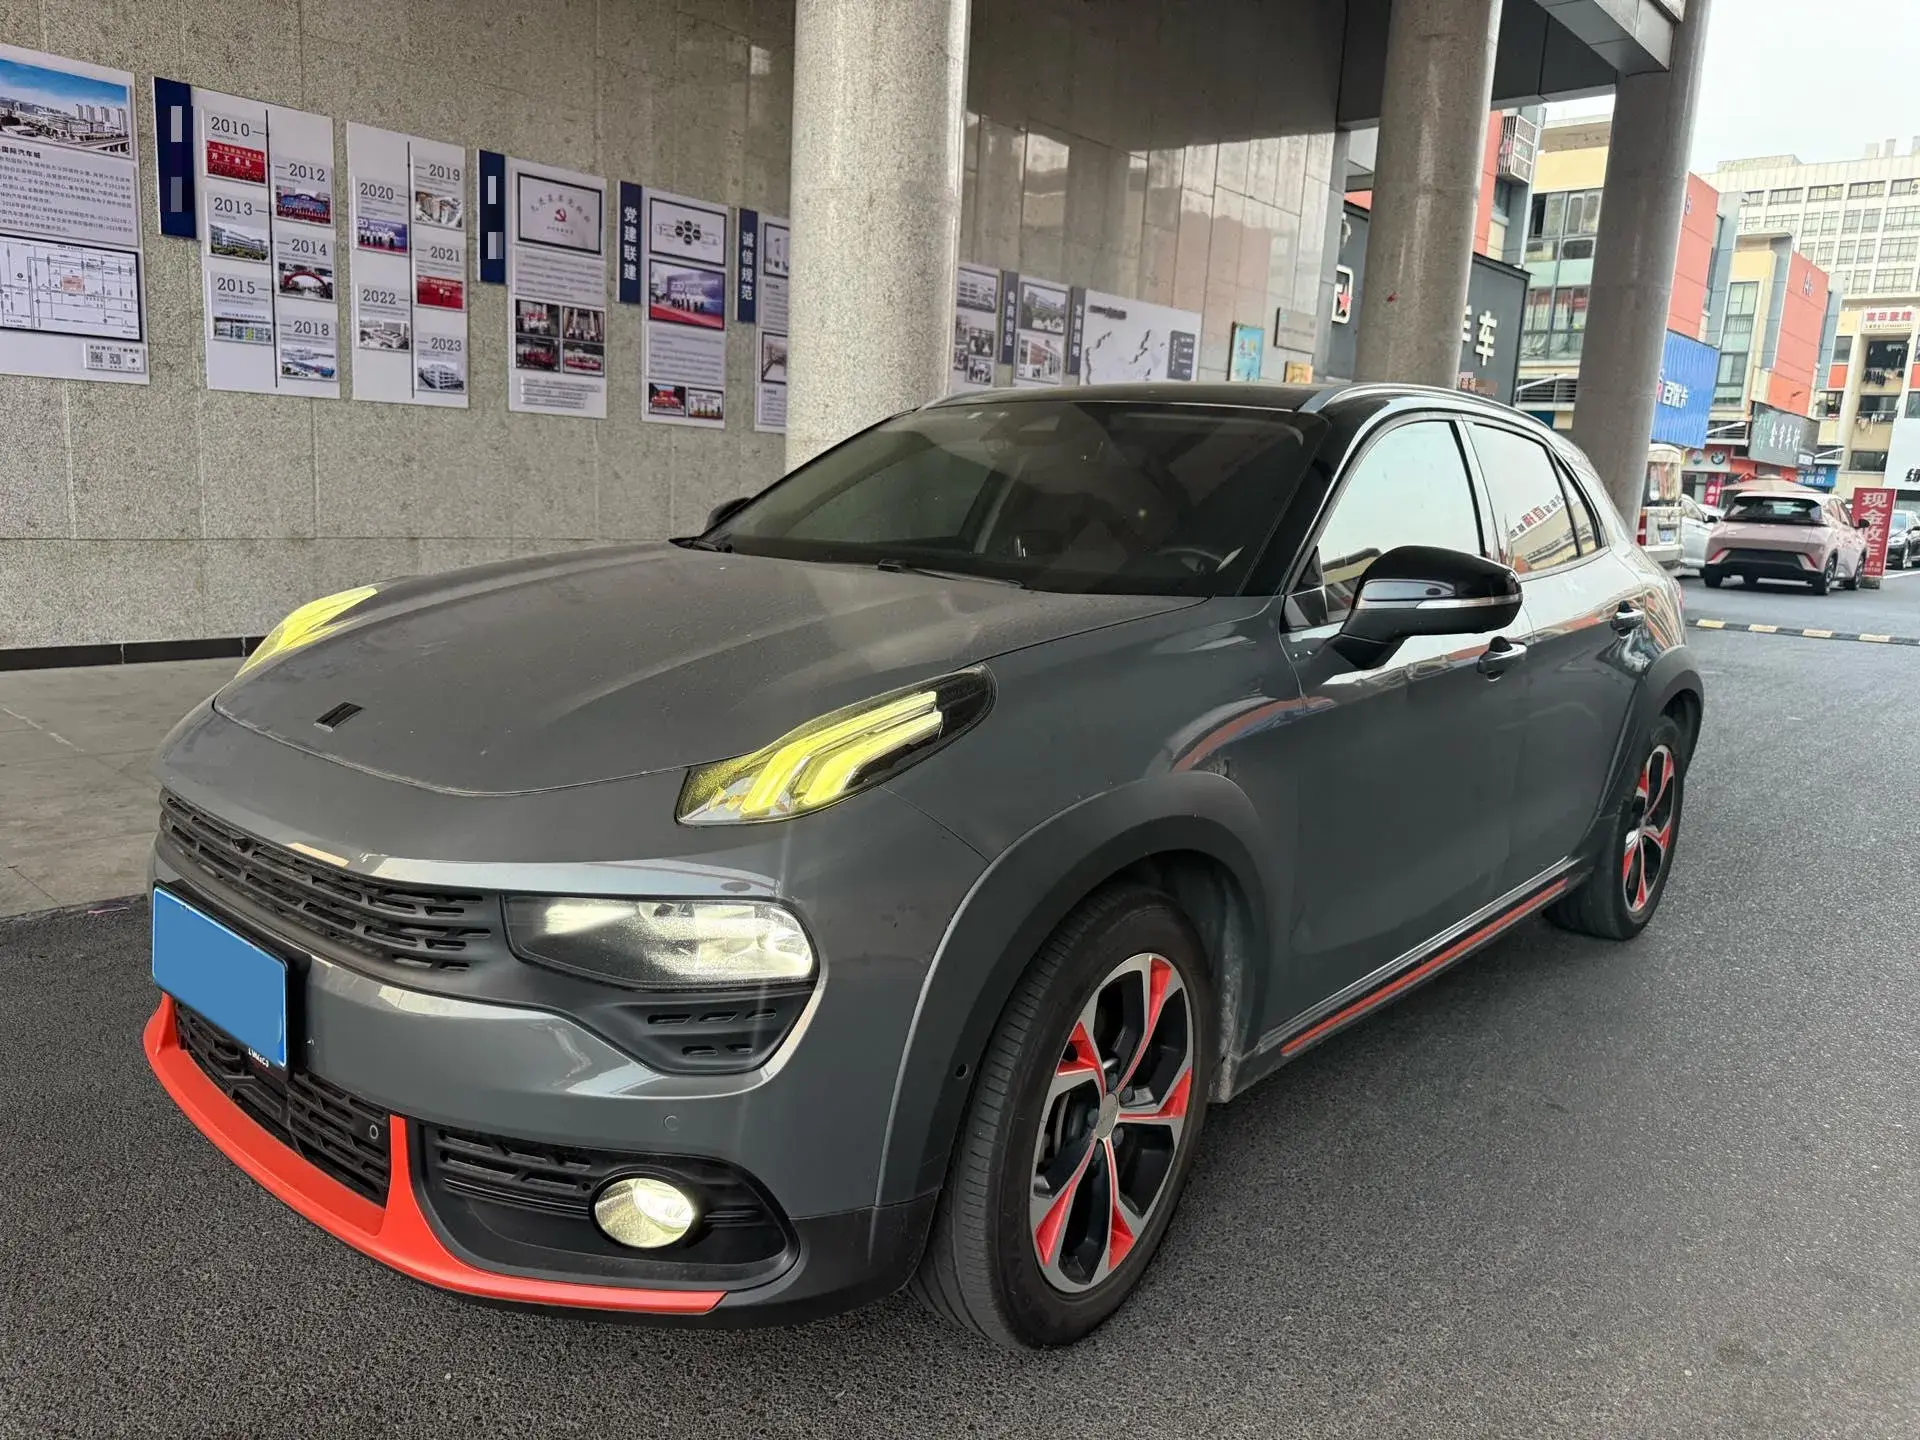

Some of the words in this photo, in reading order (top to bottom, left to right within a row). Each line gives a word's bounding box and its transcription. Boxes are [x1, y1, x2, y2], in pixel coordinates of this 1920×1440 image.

[211, 117, 250, 137] 2010
[0, 145, 41, 159] 国际汽车城
[289, 163, 326, 182] 2012
[429, 163, 461, 182] 2019
[360, 183, 394, 201] 2020
[214, 197, 253, 216] 2013
[292, 238, 328, 257] 2014
[623, 206, 638, 281] 党建联建
[430, 246, 461, 262] 2021
[741, 232, 755, 301] 诚信规范
[216, 277, 256, 295] 2015
[362, 289, 397, 305] 2022
[293, 320, 330, 337] 2018
[431, 337, 462, 353] 2023
